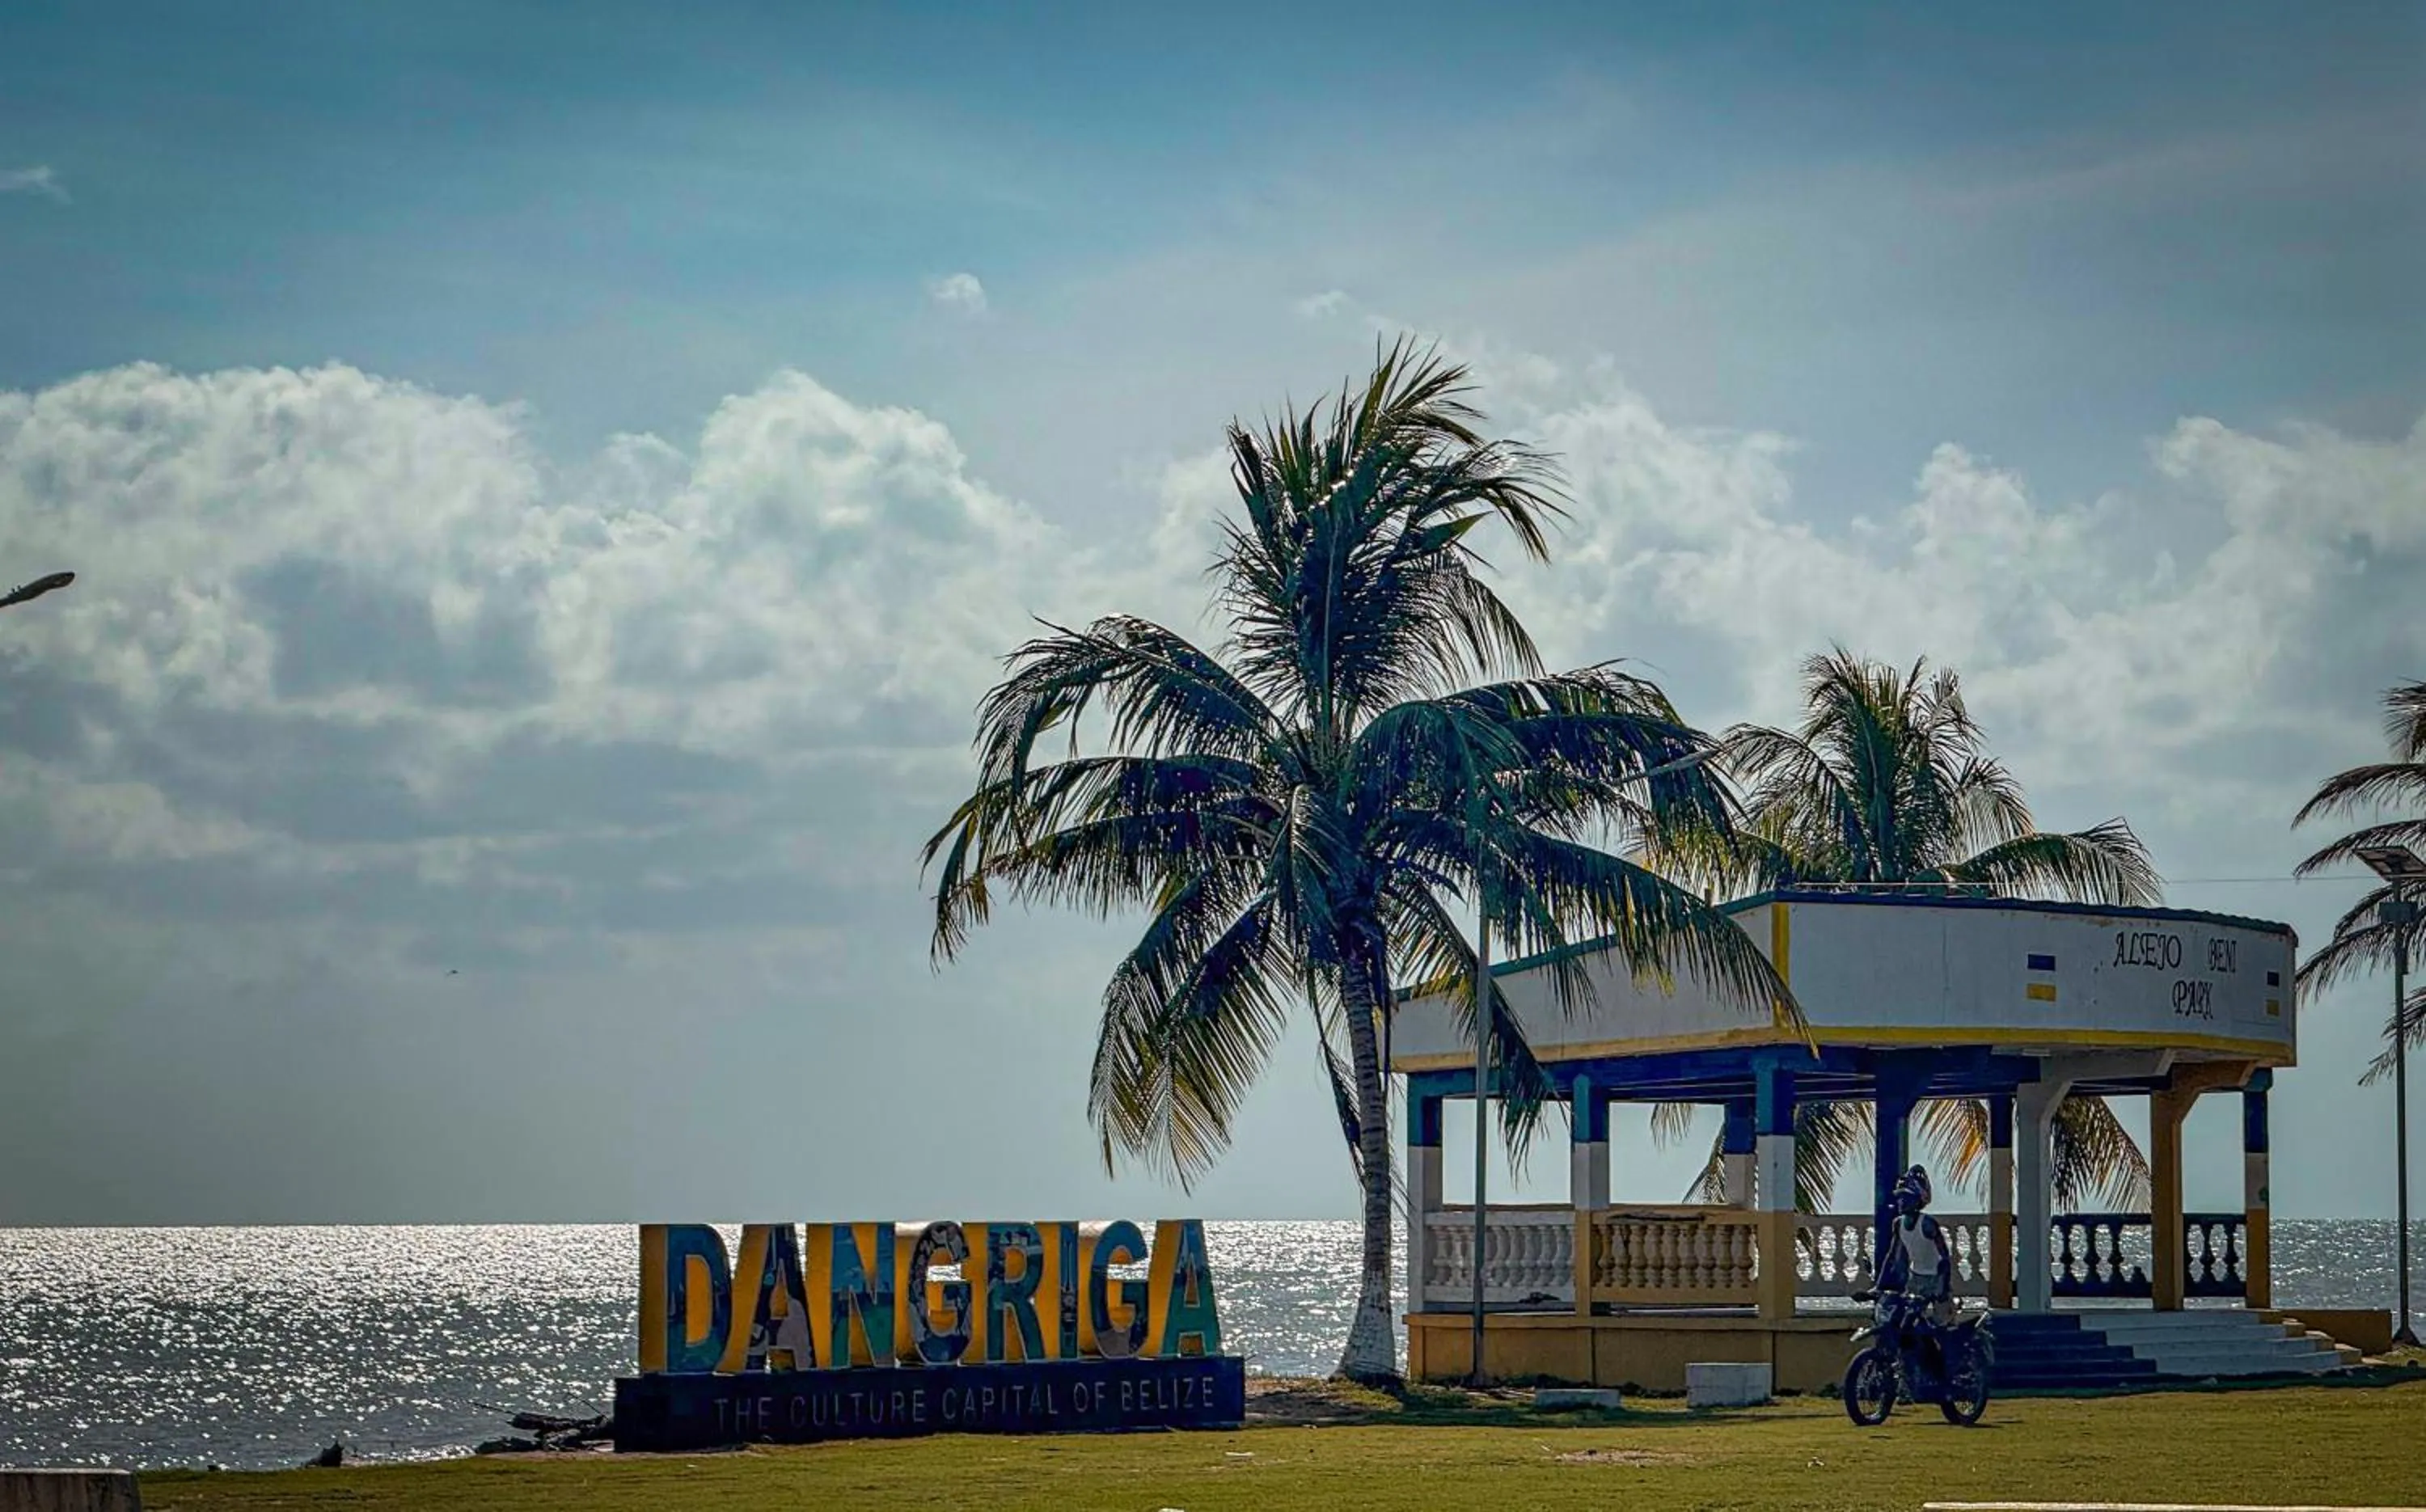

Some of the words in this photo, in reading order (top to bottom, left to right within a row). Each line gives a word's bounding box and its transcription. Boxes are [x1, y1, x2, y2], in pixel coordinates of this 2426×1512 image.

[2112, 931, 2182, 971] ALEJO
[2208, 936, 2237, 973] BENI
[2172, 979, 2213, 1020] PARK
[665, 1219, 1221, 1373] DANGRIGA
[715, 1396, 773, 1434] THE
[790, 1389, 926, 1429] CULTURE
[941, 1383, 1059, 1421] CAPITAL
[1073, 1381, 1106, 1413] OF
[1121, 1376, 1214, 1412] BELIZE
